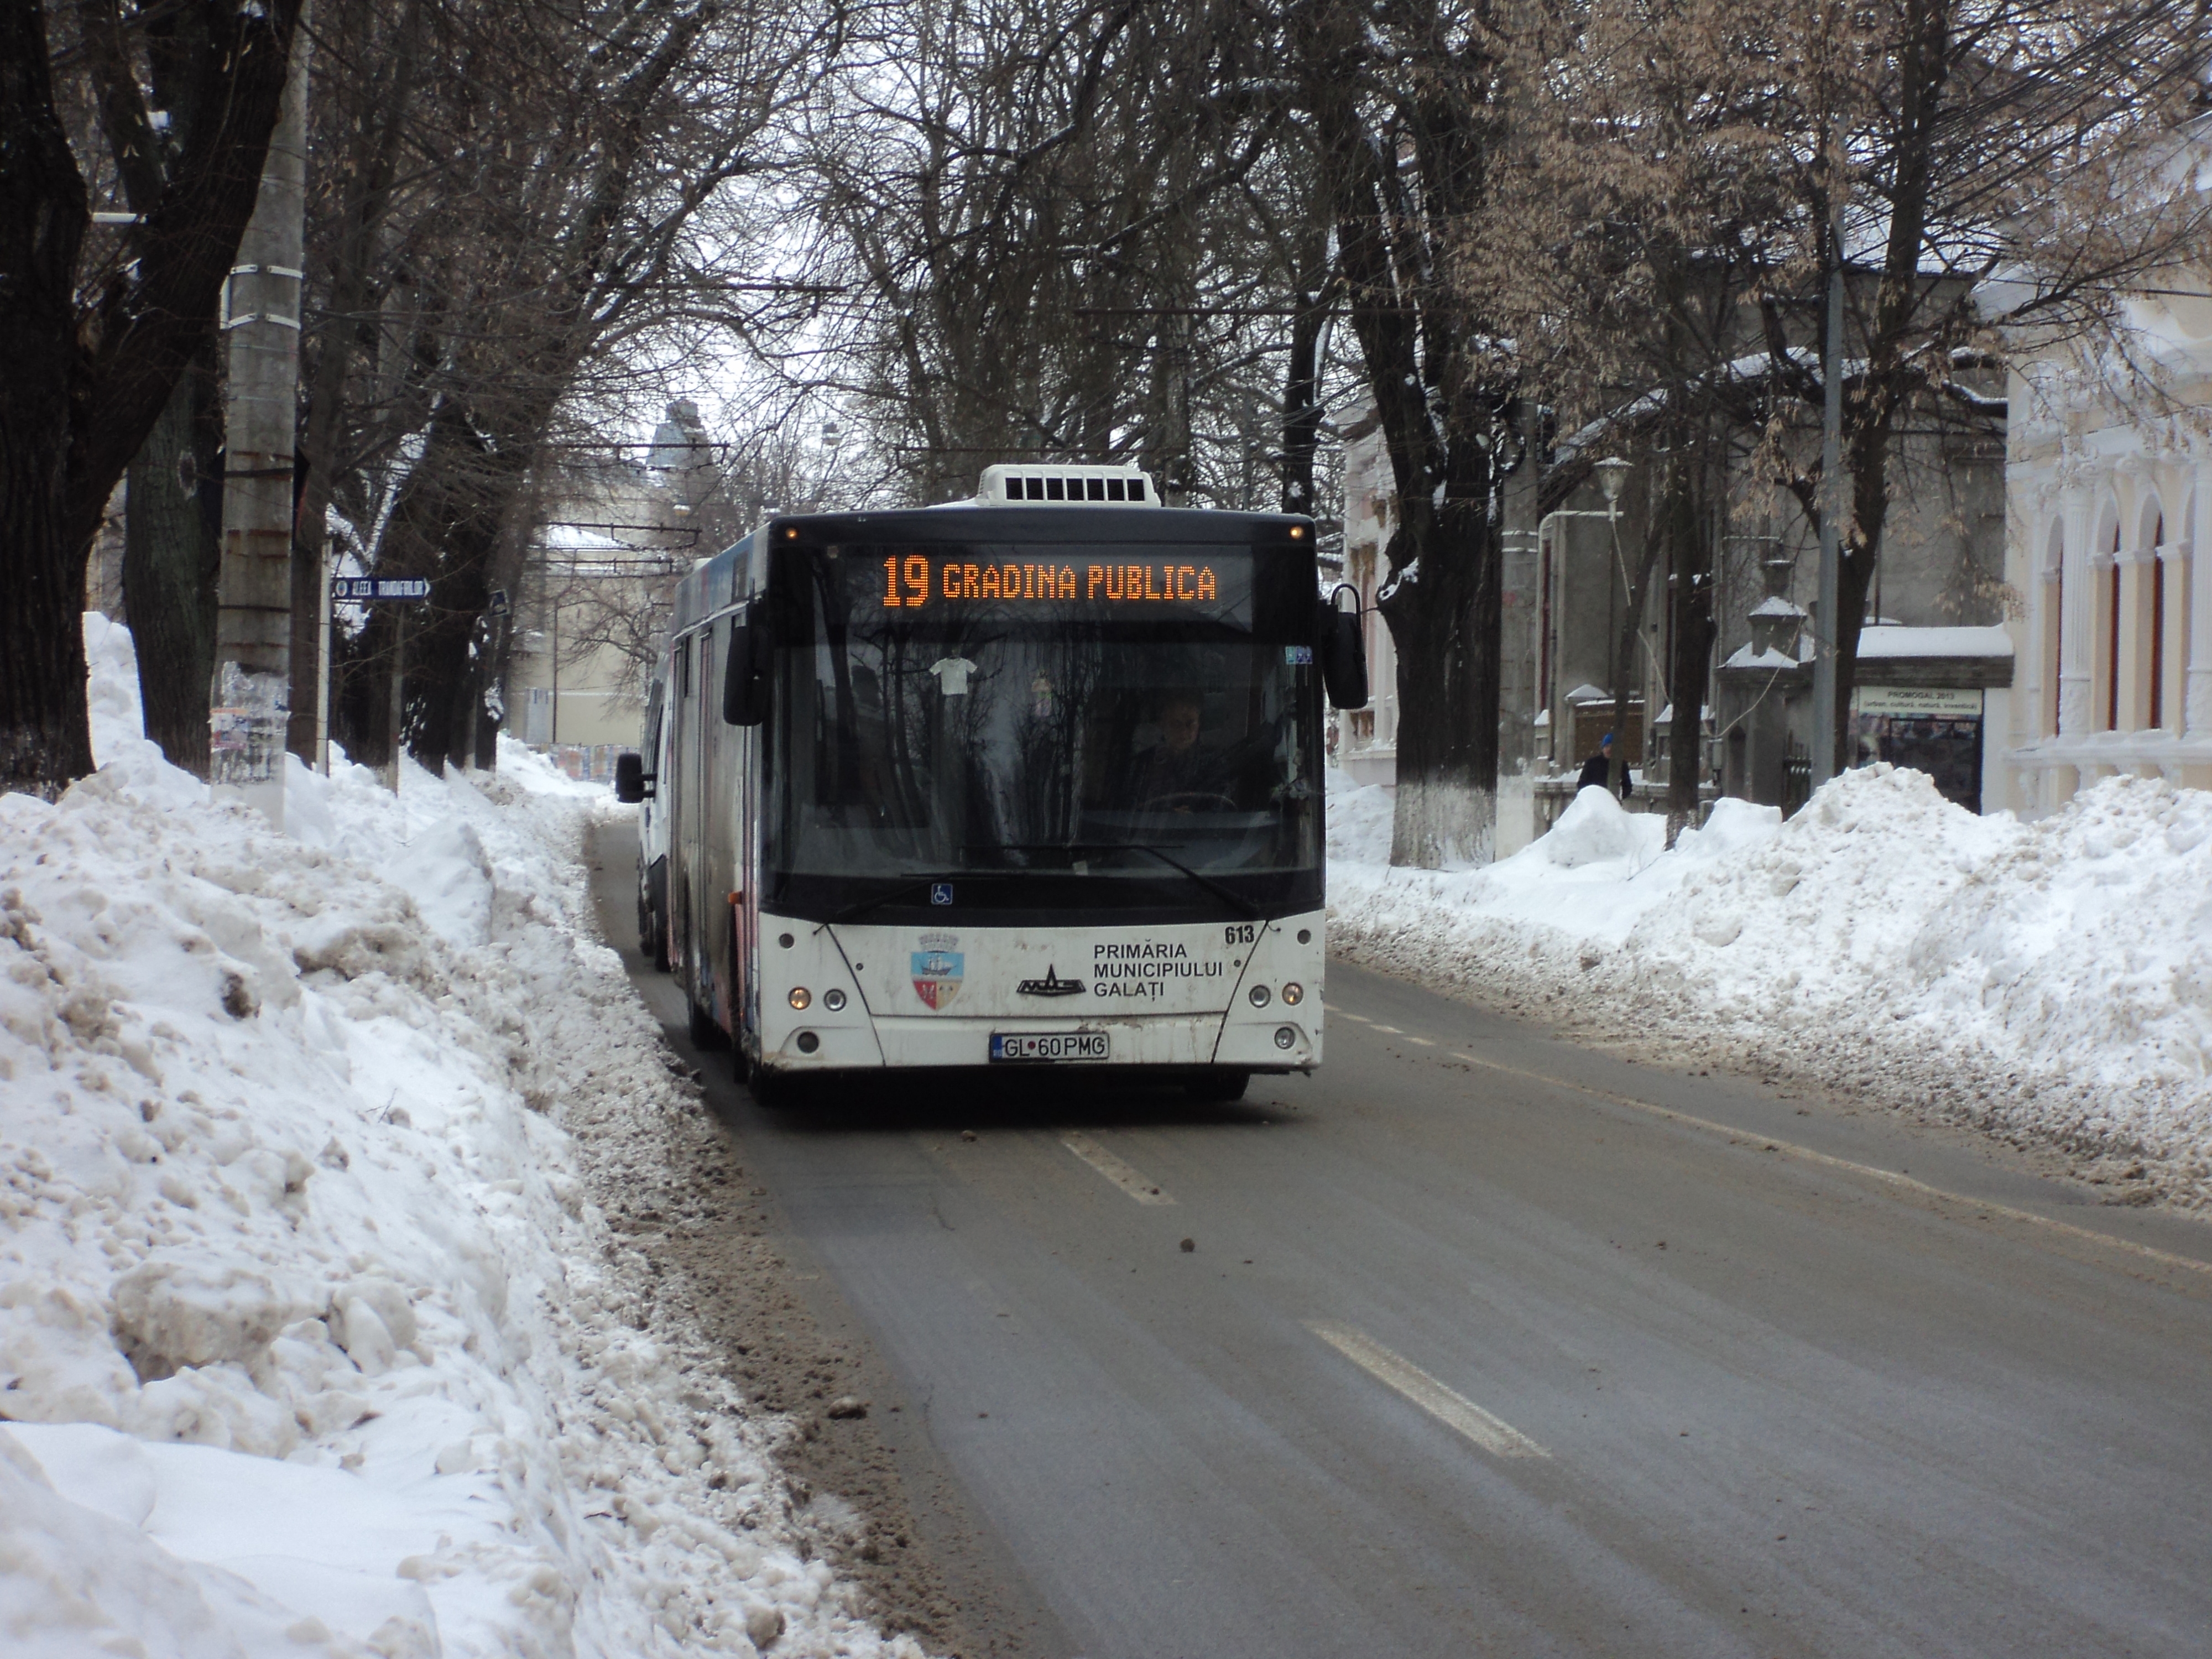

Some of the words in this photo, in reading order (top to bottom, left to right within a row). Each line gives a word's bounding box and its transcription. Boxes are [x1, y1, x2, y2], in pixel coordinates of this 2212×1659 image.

[883, 555, 928, 606] 19
[942, 564, 1076, 599] GRADINA
[1087, 565, 1216, 599] PUBLICA
[1224, 925, 1255, 944] 613
[1094, 938, 1187, 959] PRIMĂRIA
[1094, 962, 1223, 978] MUNICIPIULUI
[1094, 982, 1164, 1001] GALAȚI
